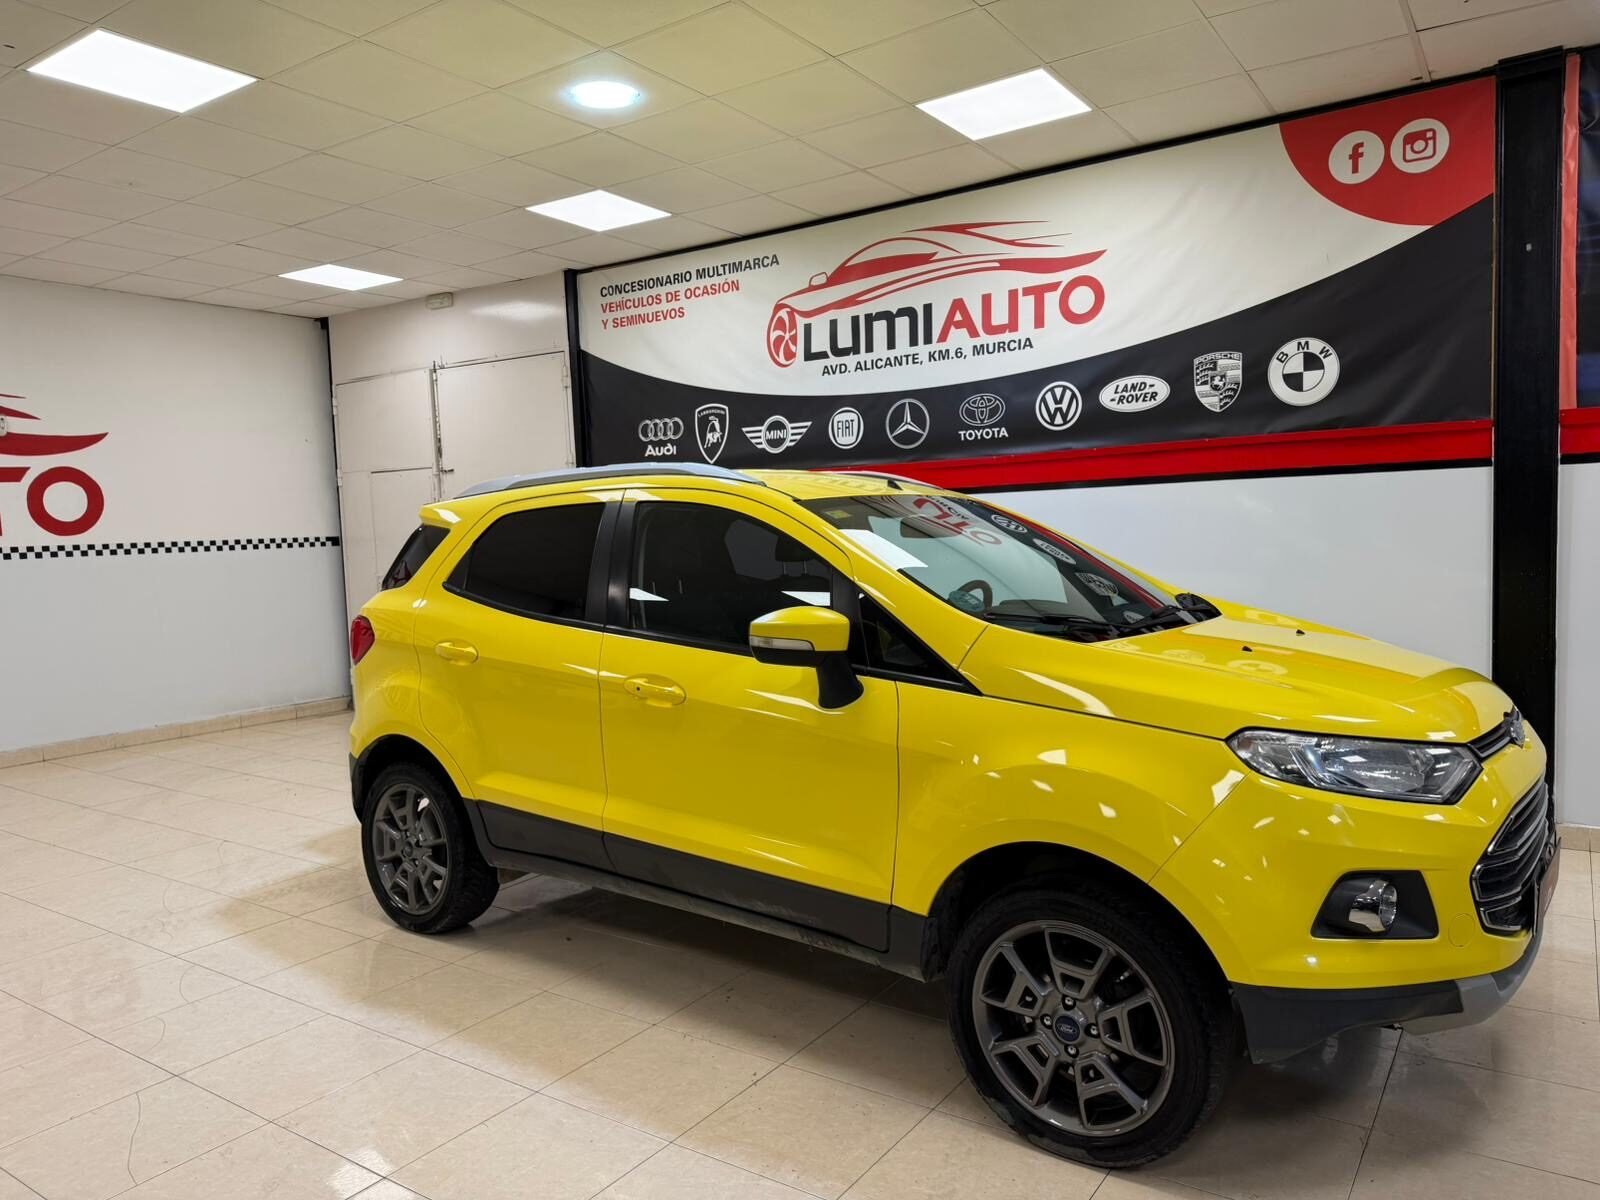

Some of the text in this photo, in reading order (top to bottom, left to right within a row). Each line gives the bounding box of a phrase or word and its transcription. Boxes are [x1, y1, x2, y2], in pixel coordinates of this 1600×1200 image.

[600, 254, 780, 298] CONCESIONARIO MULTIMARCA
[601, 277, 740, 314] VEHÍCULOS DE OCASIÓN
[602, 306, 685, 330] Y SEMINUEVOS
[821, 337, 1034, 377] AVD. ALICANTE, KM.6, MURCIA
[1276, 340, 1332, 364] BMW
[765, 429, 788, 441] MINI
[836, 418, 855, 437] FIAT
[958, 426, 1009, 442] TOYOTA
[644, 444, 677, 457] Audi
